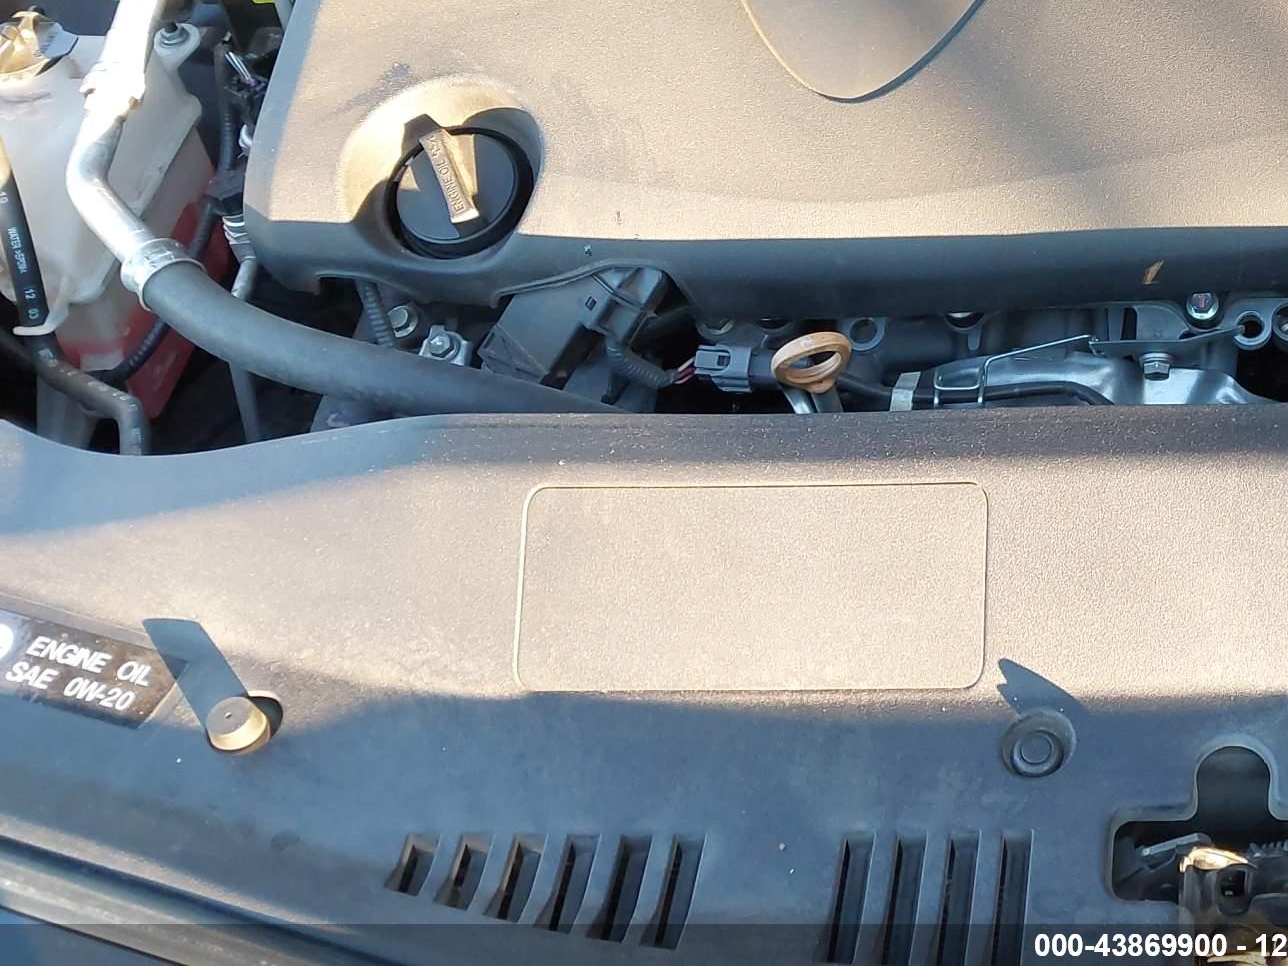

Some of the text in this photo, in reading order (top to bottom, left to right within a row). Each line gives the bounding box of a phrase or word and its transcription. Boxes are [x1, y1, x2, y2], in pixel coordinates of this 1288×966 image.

[436, 158, 465, 212] ENGINE OIL
[7, 227, 21, 249] WATER
[5, 660, 136, 711] SAE 0W-20
[25, 635, 152, 687] ENGINE OIL
